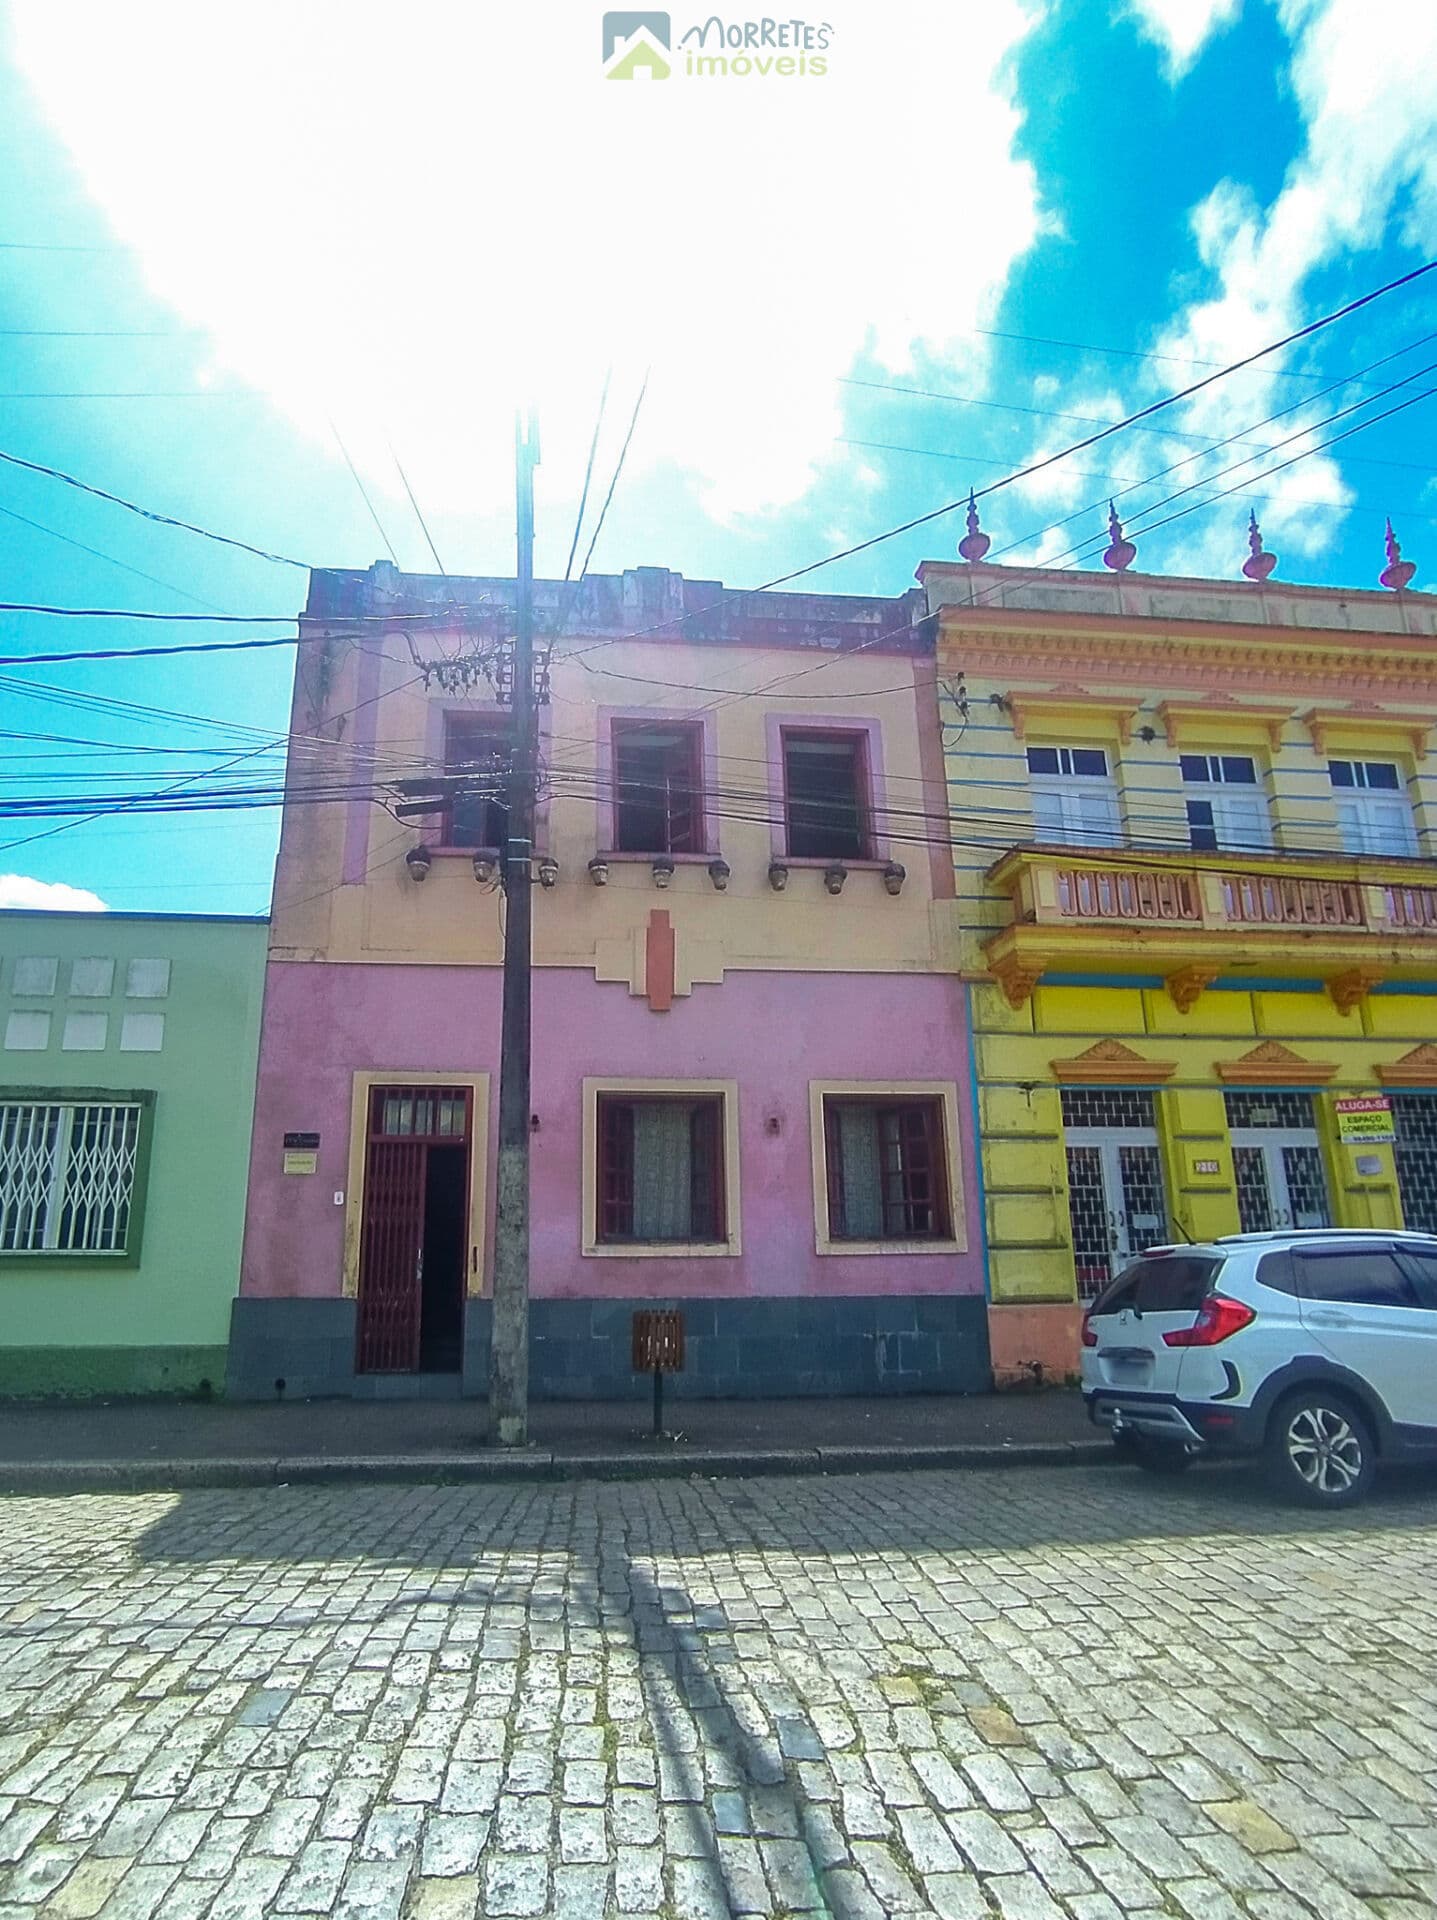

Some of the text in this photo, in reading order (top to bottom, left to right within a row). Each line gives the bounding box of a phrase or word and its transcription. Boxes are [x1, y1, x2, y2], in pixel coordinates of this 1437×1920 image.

[1335, 1099, 1390, 1111] ALUGA-SE
[1346, 1114, 1382, 1124] ESPAÇO
[1342, 1124, 1391, 1133] COMERCIAL
